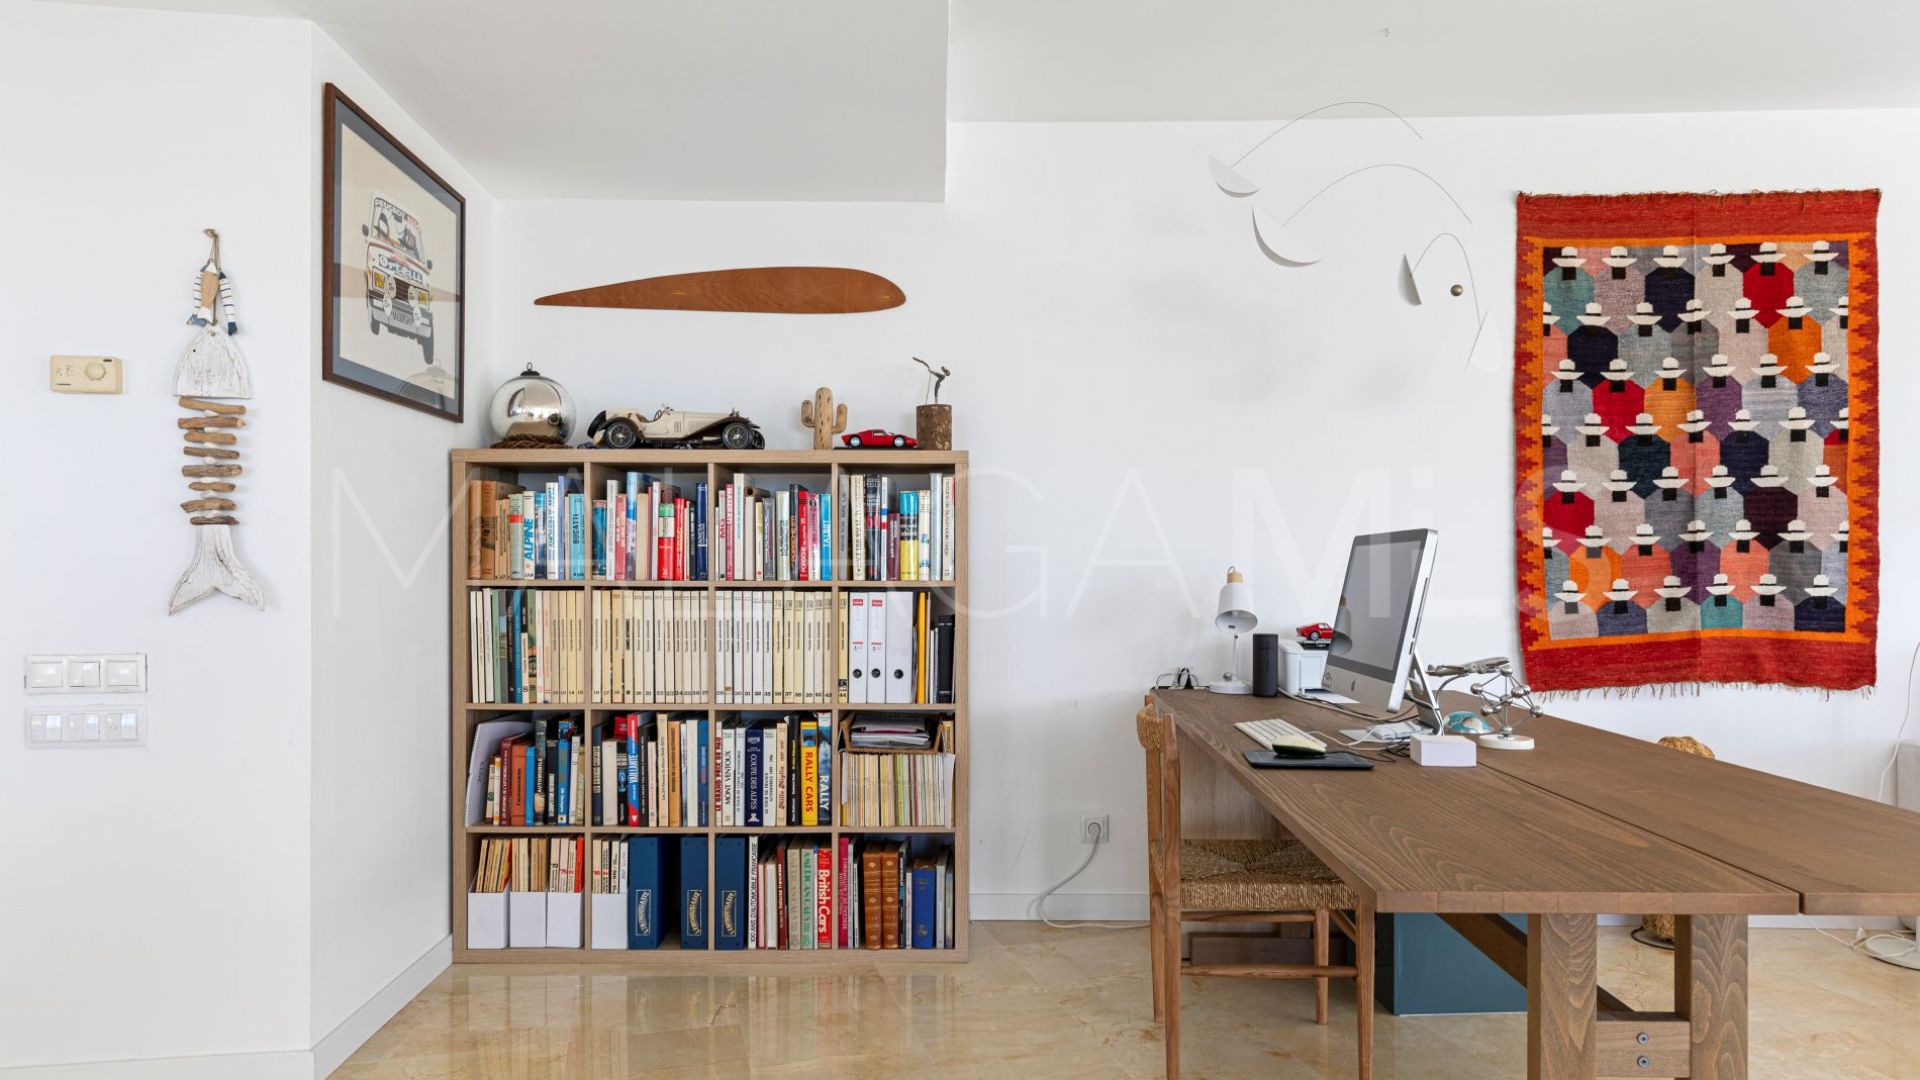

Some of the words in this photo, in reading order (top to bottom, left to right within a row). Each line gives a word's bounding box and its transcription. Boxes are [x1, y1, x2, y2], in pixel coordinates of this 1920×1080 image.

[524, 518, 533, 560] ALPINE
[629, 754, 638, 783] VAILLANTE
[805, 786, 813, 812] CARS
[820, 775, 829, 810] RALLY
[819, 870, 831, 904] British
[819, 906, 830, 933] Cars
